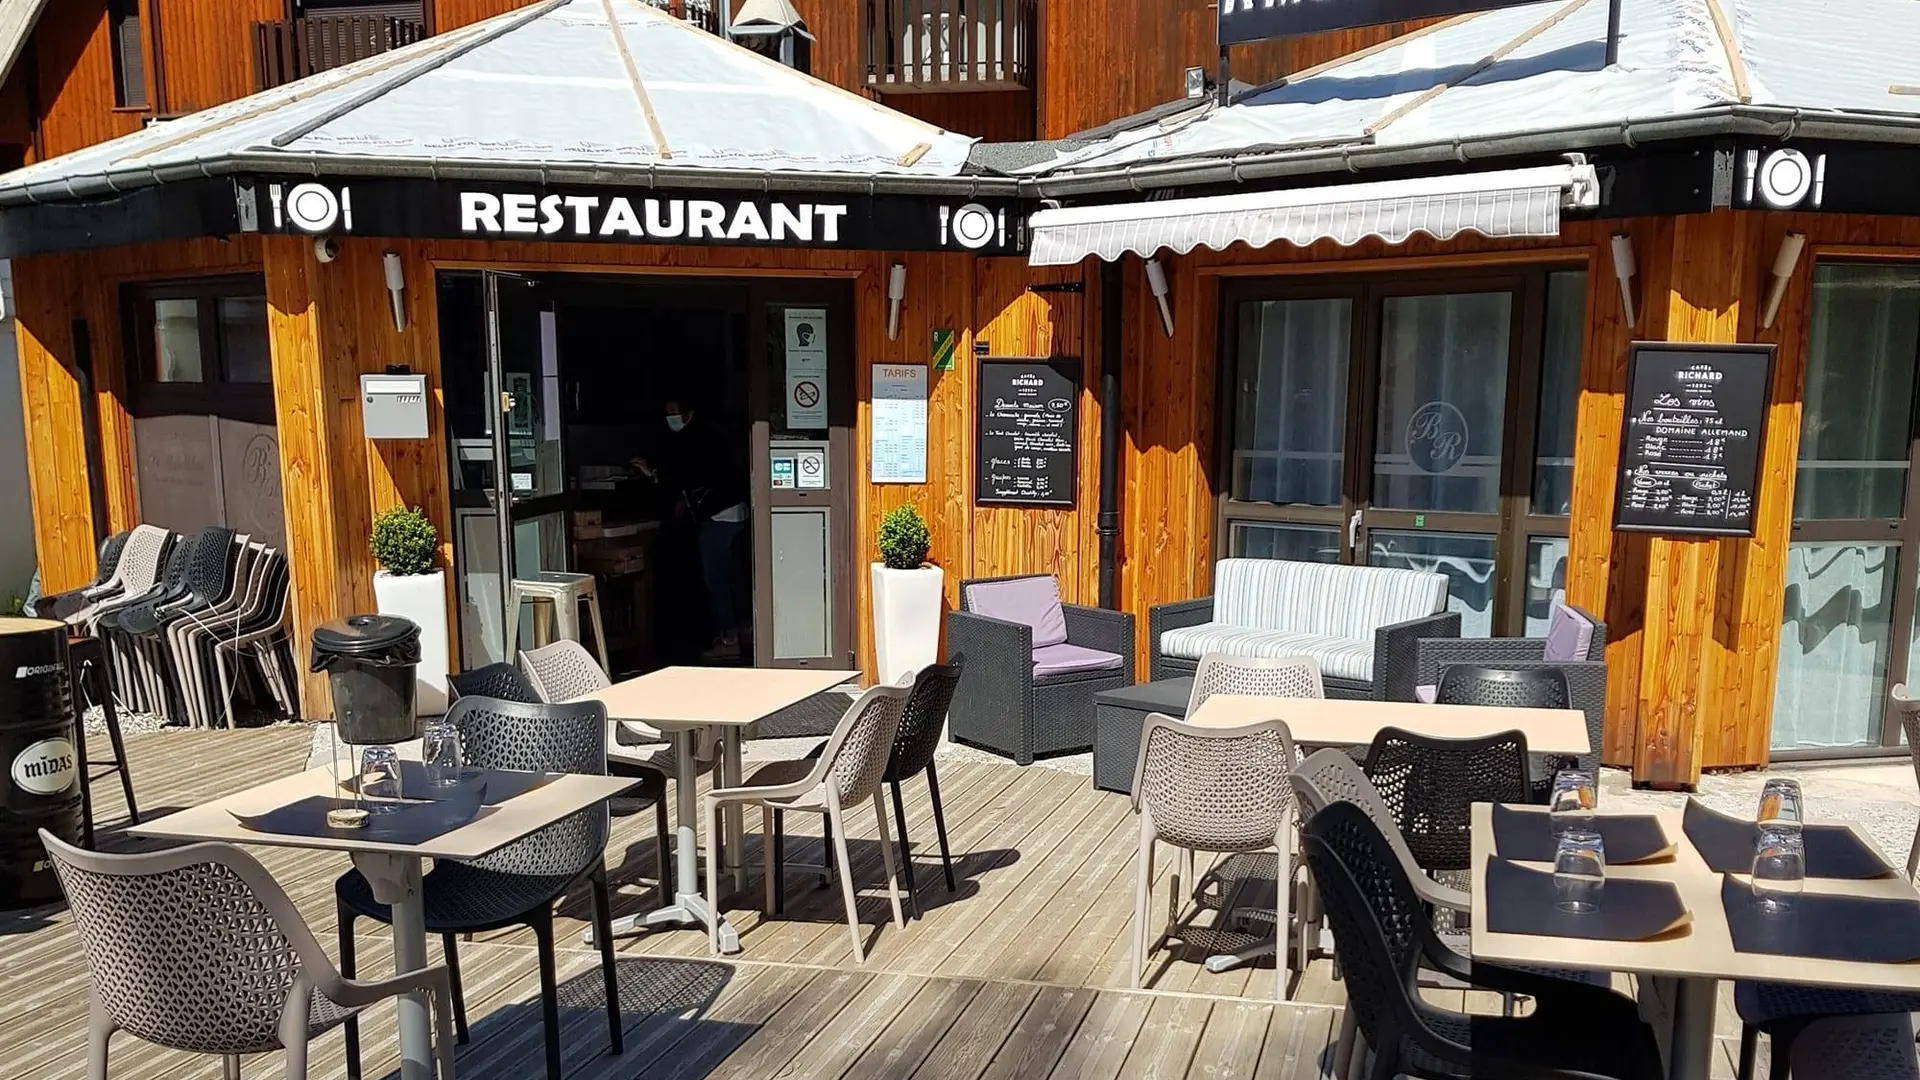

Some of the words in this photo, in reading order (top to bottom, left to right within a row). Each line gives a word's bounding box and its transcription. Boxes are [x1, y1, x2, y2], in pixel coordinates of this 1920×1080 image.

[460, 192, 847, 242] RESTAURANT
[883, 368, 917, 378] TARIFS
[1678, 371, 1723, 380] RICHARD
[1654, 394, 1681, 406] Les
[1688, 395, 1715, 407] vins
[1638, 410, 1654, 423] Nos
[1656, 426, 1696, 435] DOMAINE
[1701, 428, 1748, 437] ALLEMAND
[1645, 435, 1668, 446] Rouge
[1645, 443, 1667, 451] Blanc
[1644, 449, 1662, 457] Rosé
